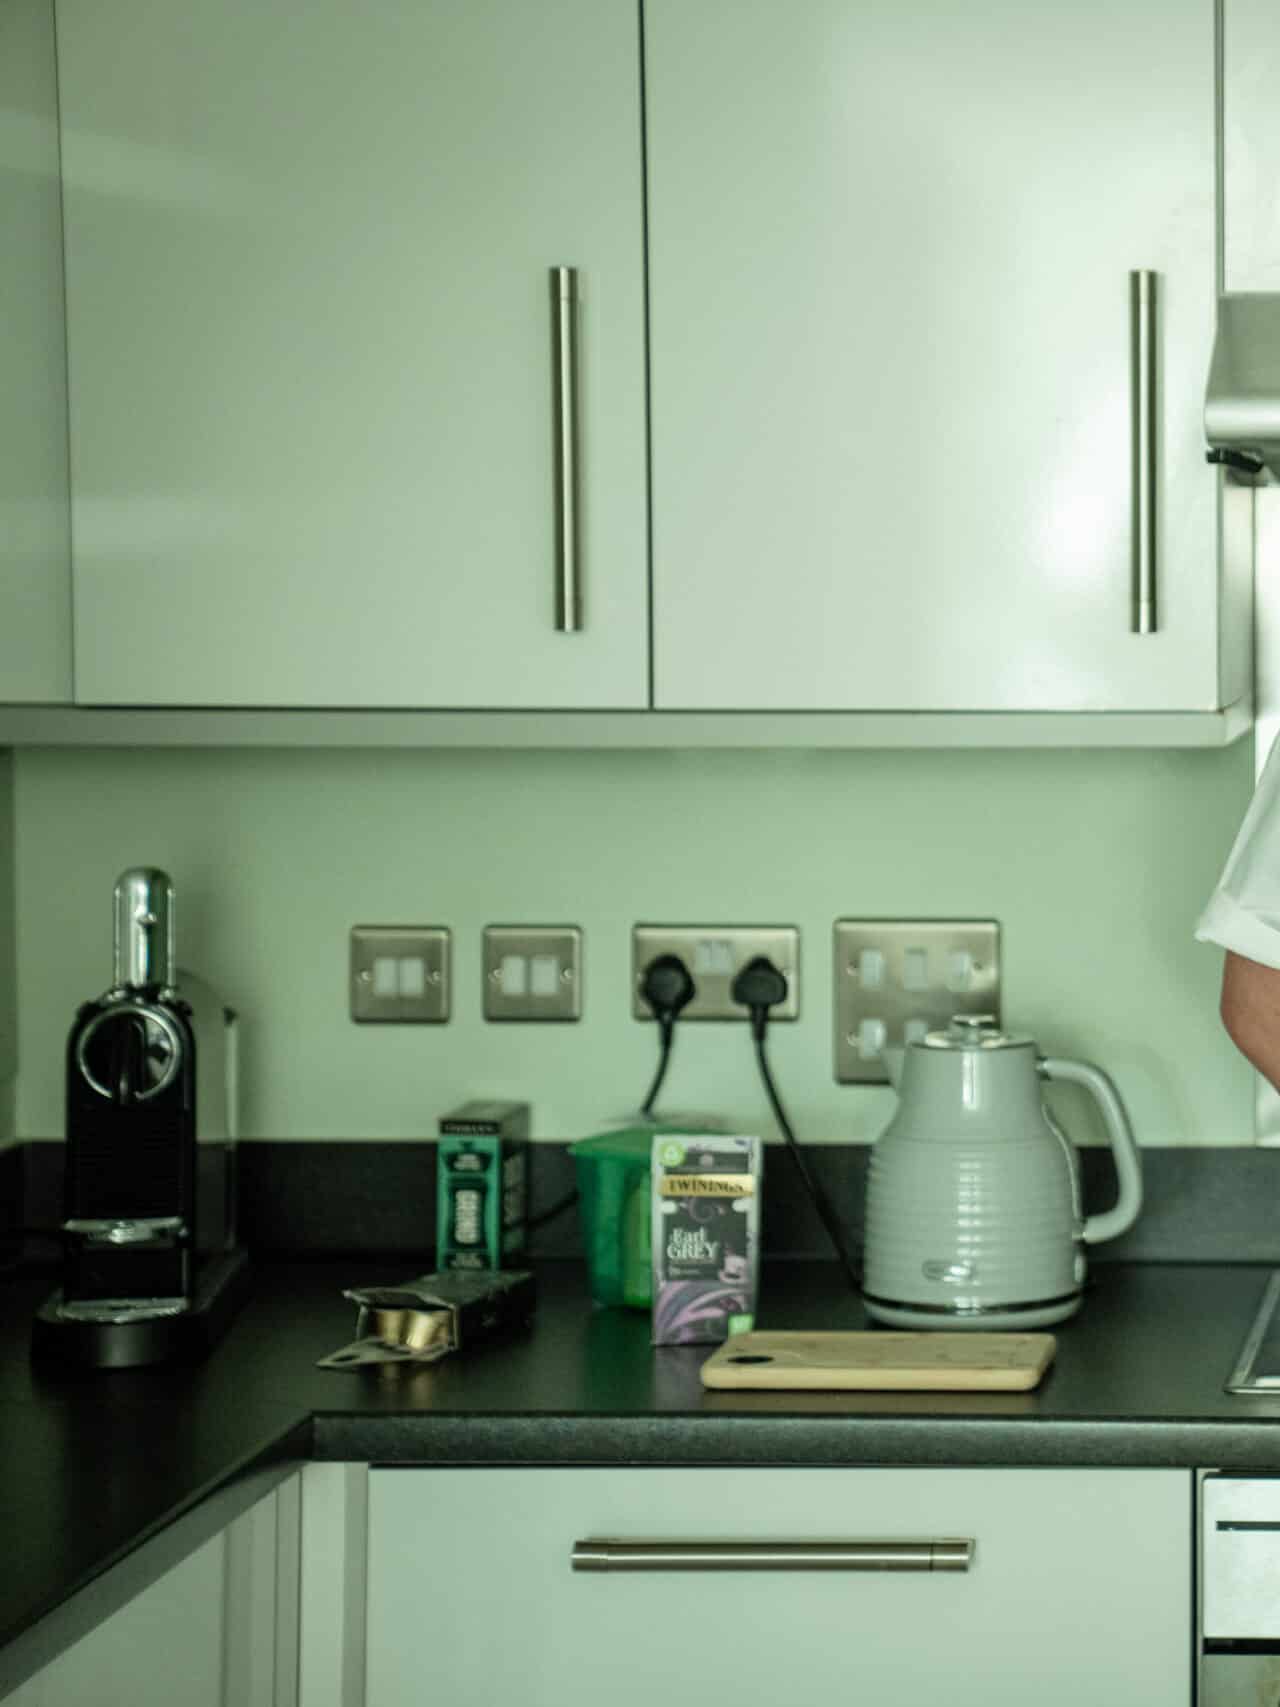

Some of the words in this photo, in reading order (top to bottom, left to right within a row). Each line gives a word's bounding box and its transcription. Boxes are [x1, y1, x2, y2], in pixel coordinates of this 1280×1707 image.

[668, 1178, 745, 1193] TWININGS
[671, 1227, 706, 1242] Earl
[667, 1241, 718, 1260] GREY
